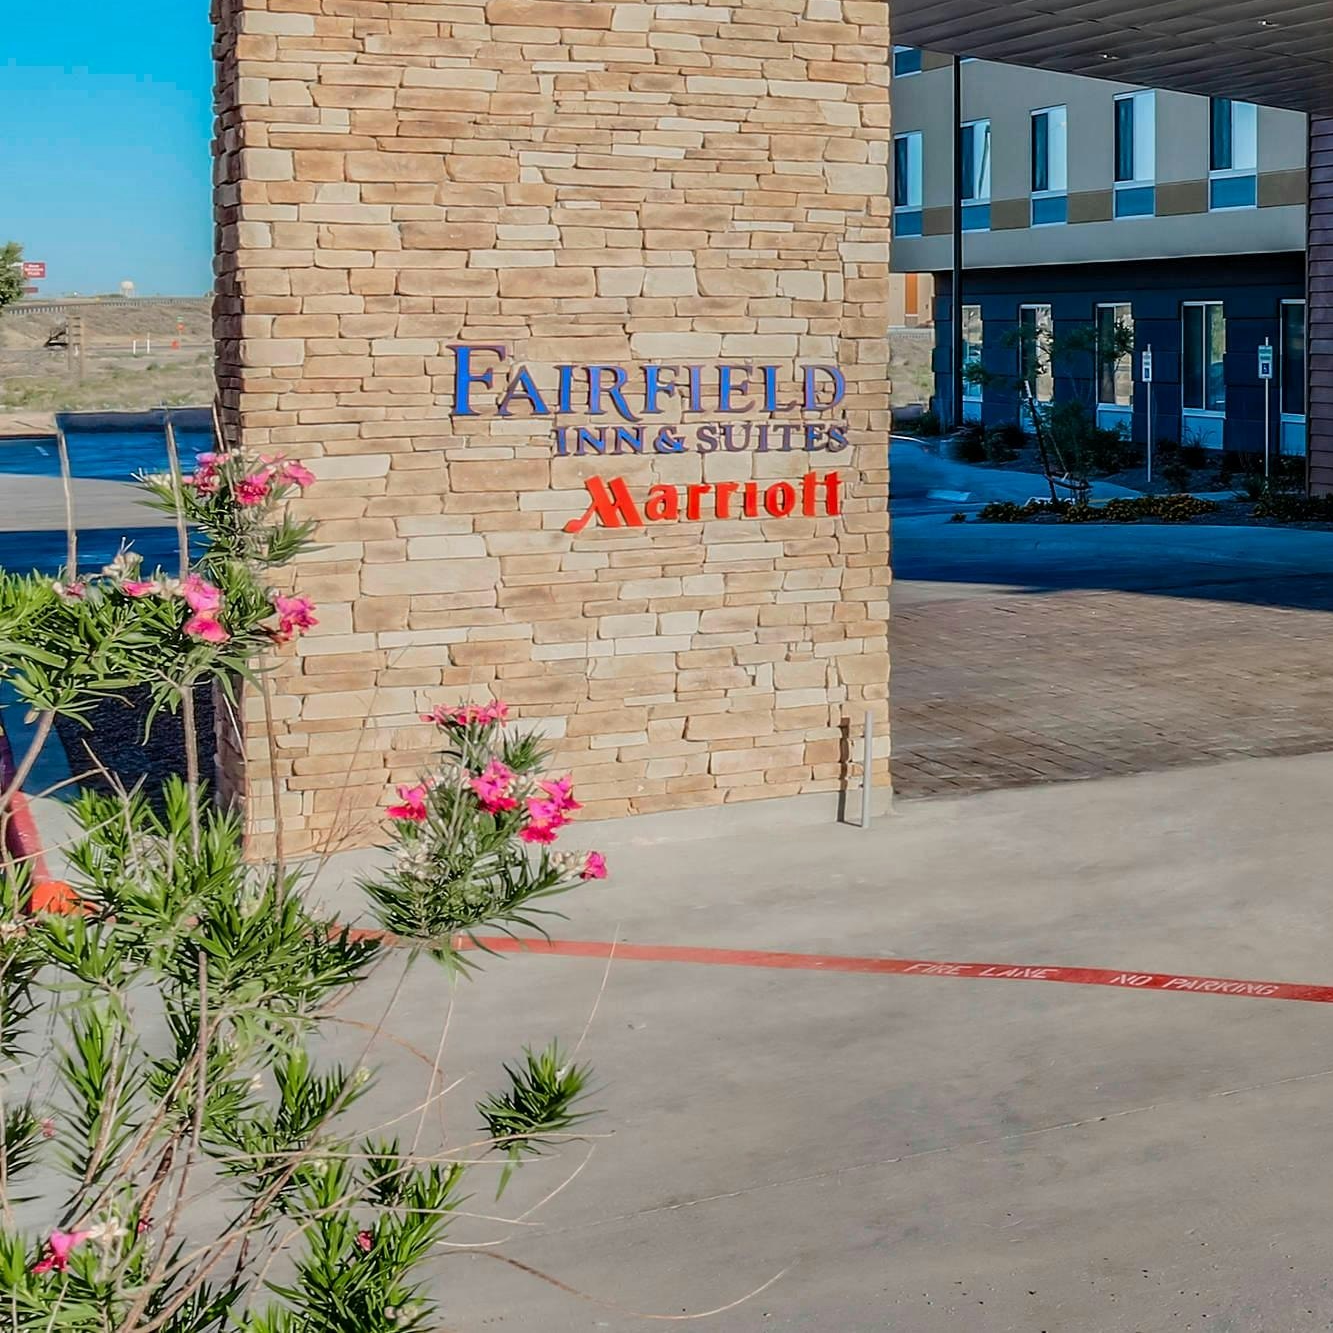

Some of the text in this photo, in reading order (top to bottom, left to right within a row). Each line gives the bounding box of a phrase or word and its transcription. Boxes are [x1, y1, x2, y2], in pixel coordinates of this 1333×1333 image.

[447, 344, 847, 422] FAIRFIELD
[563, 470, 842, 533] Marriott
[903, 963, 972, 976] FIRE
[979, 967, 1059, 979] LANE
[1110, 973, 1153, 987] NO
[1162, 977, 1280, 996] PARKING
